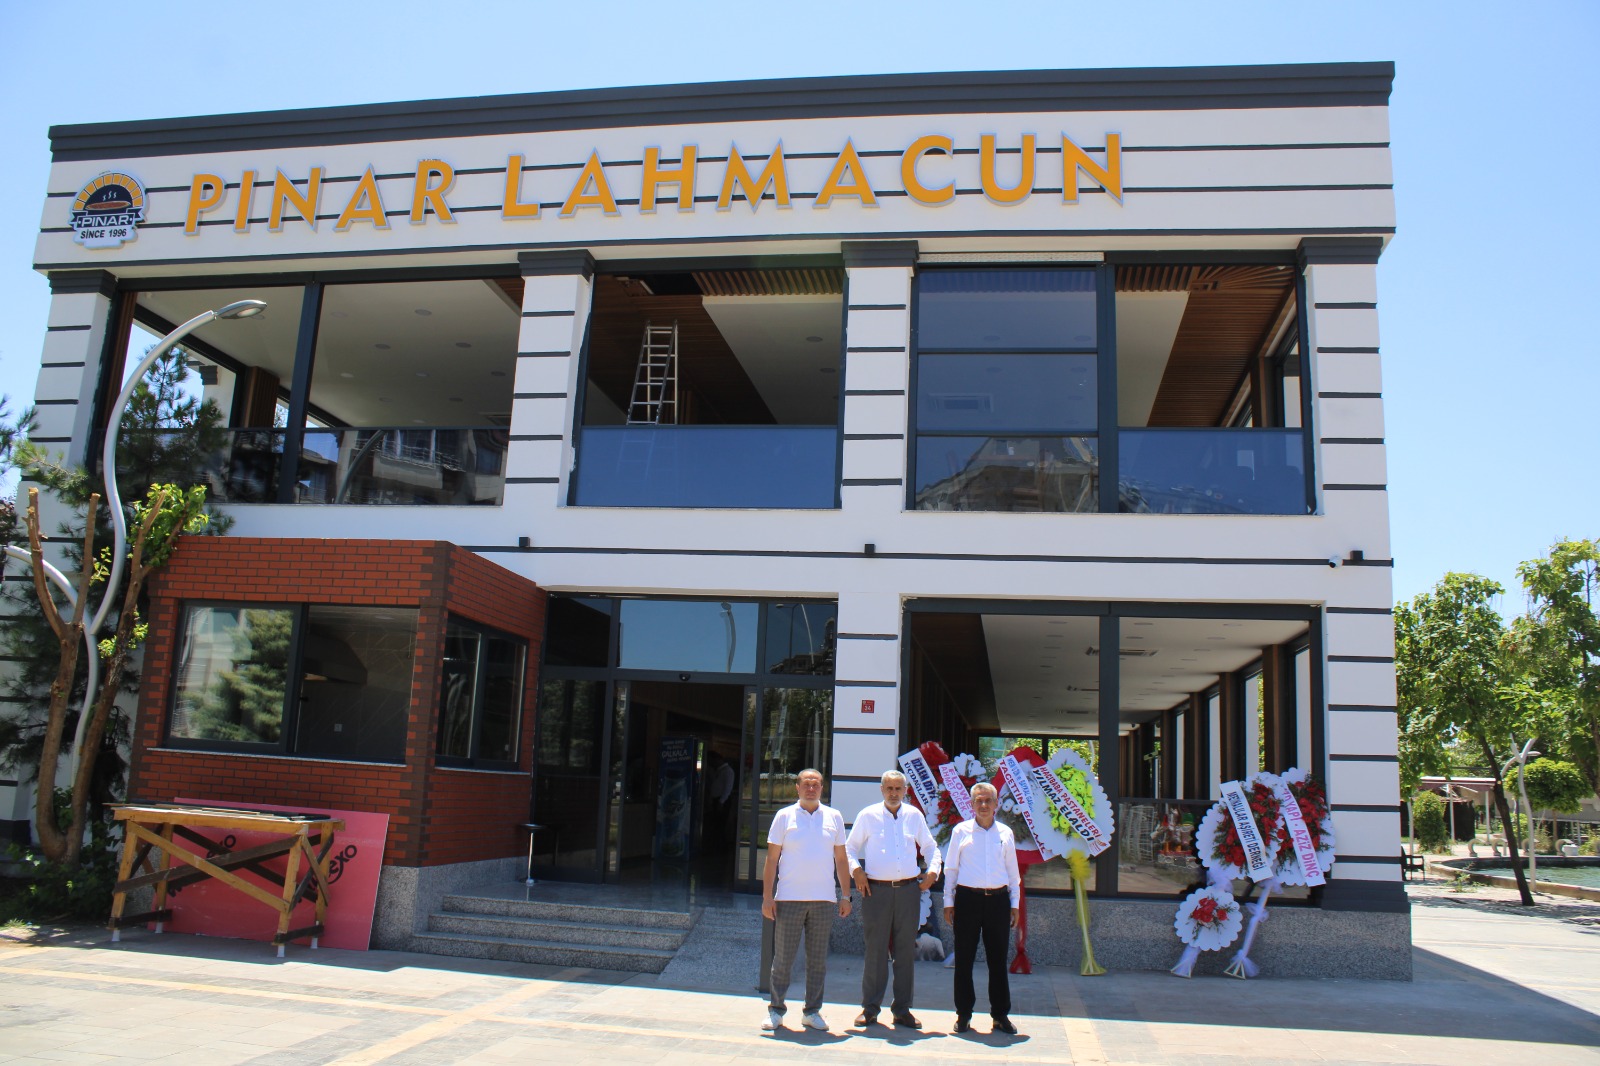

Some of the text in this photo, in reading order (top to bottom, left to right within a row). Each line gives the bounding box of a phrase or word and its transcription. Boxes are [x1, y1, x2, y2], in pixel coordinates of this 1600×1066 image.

[184, 131, 1123, 234] PINAR LAHMACUN
[81, 216, 129, 227] PINAR
[109, 228, 127, 238] 1996
[940, 766, 956, 791] AHMET
[1000, 760, 1025, 805] TACETTİN
[1032, 769, 1062, 804] YILMAZ
[1060, 805, 1095, 842] ELALDI
